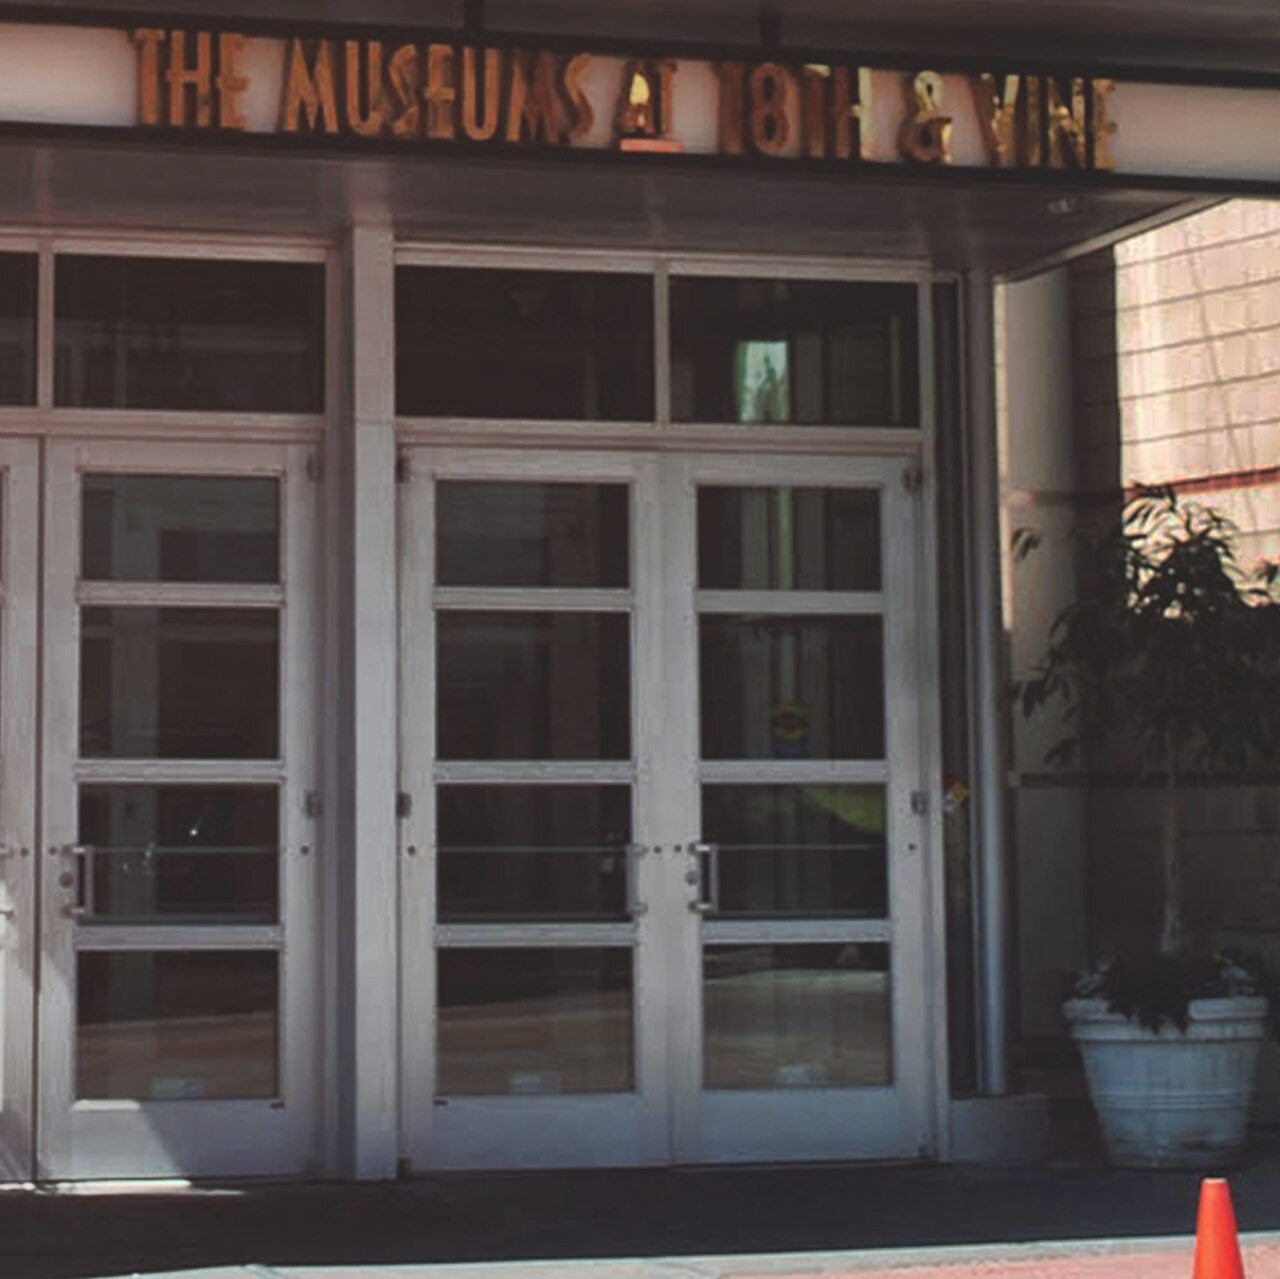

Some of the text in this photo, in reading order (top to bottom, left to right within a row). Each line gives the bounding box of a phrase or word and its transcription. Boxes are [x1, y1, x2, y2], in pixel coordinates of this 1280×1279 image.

[132, 27, 249, 130] THE
[283, 36, 596, 146] MUSEUMS
[715, 62, 877, 160] 18TH
[900, 69, 953, 164] &
[974, 72, 1118, 172] VINE
